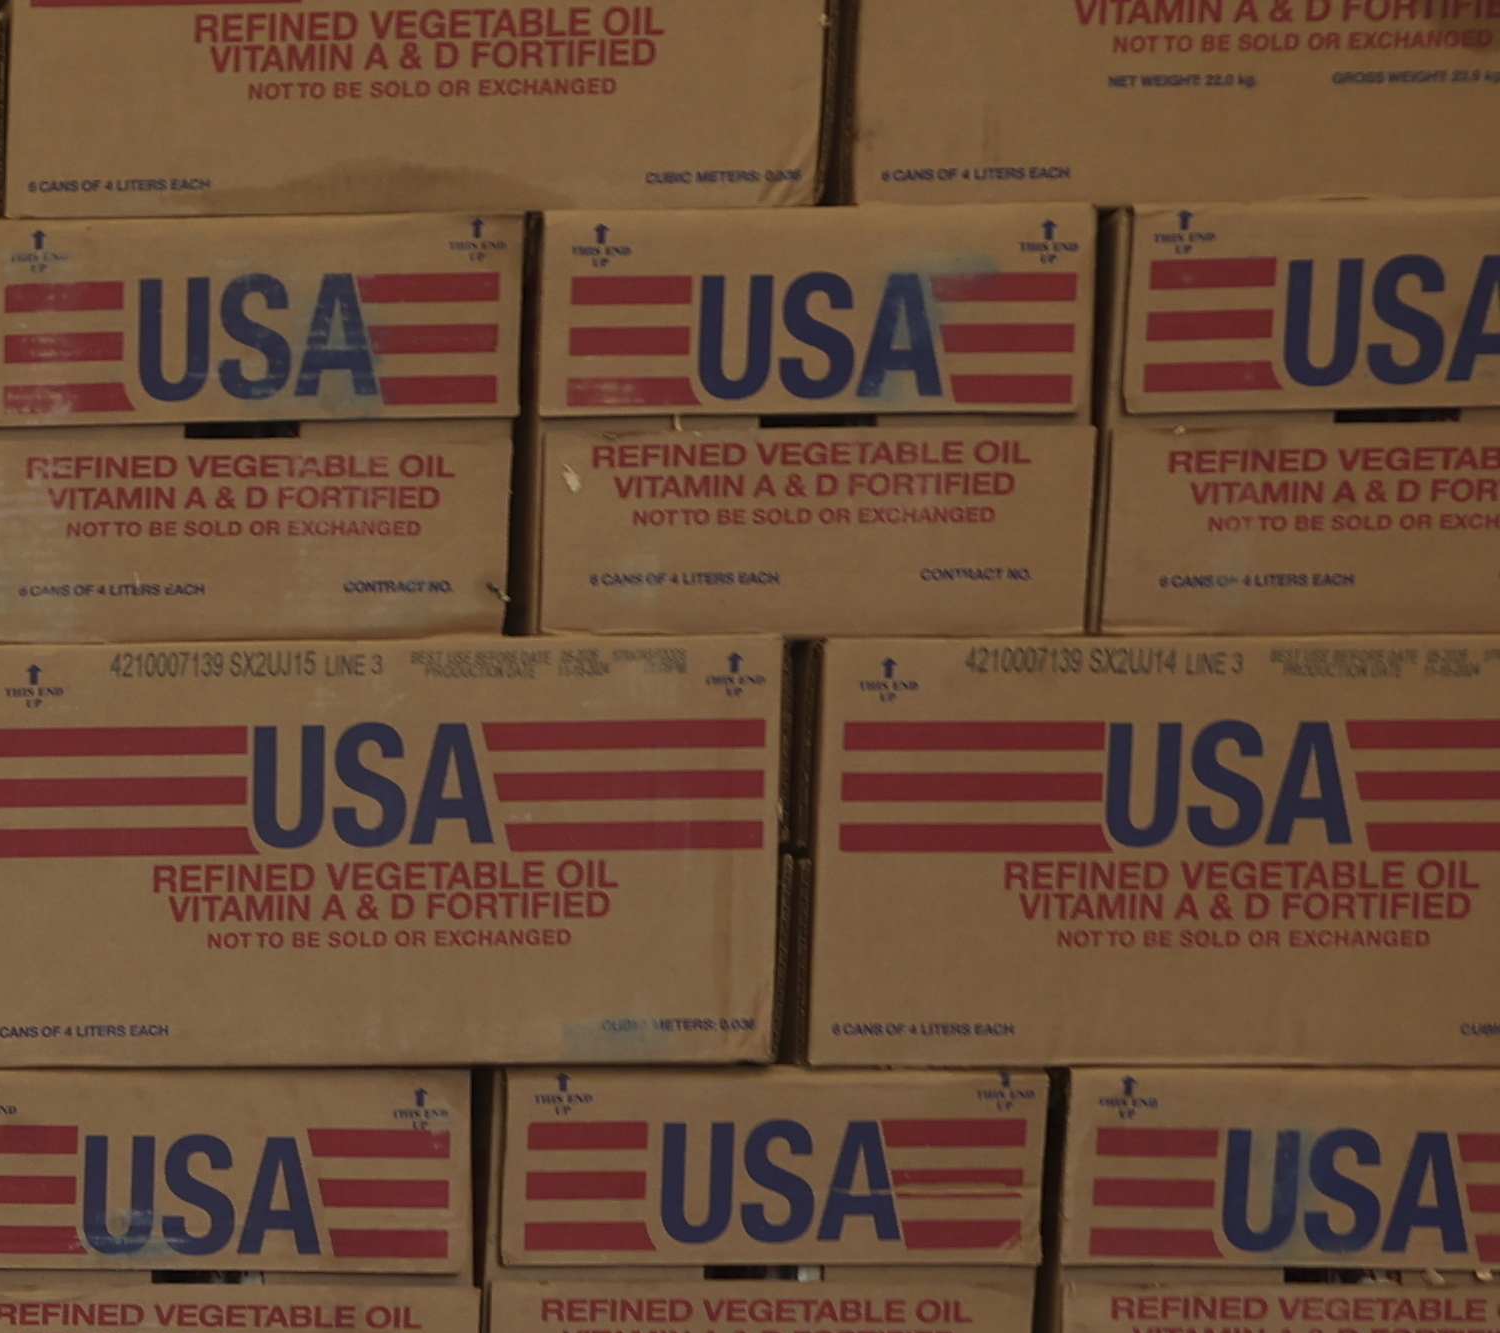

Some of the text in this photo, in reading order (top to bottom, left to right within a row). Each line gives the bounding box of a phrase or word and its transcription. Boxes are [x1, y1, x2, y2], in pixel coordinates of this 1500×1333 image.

[699, 272, 942, 400] USA
[254, 722, 494, 848] USA
[661, 1119, 901, 1244] USA
